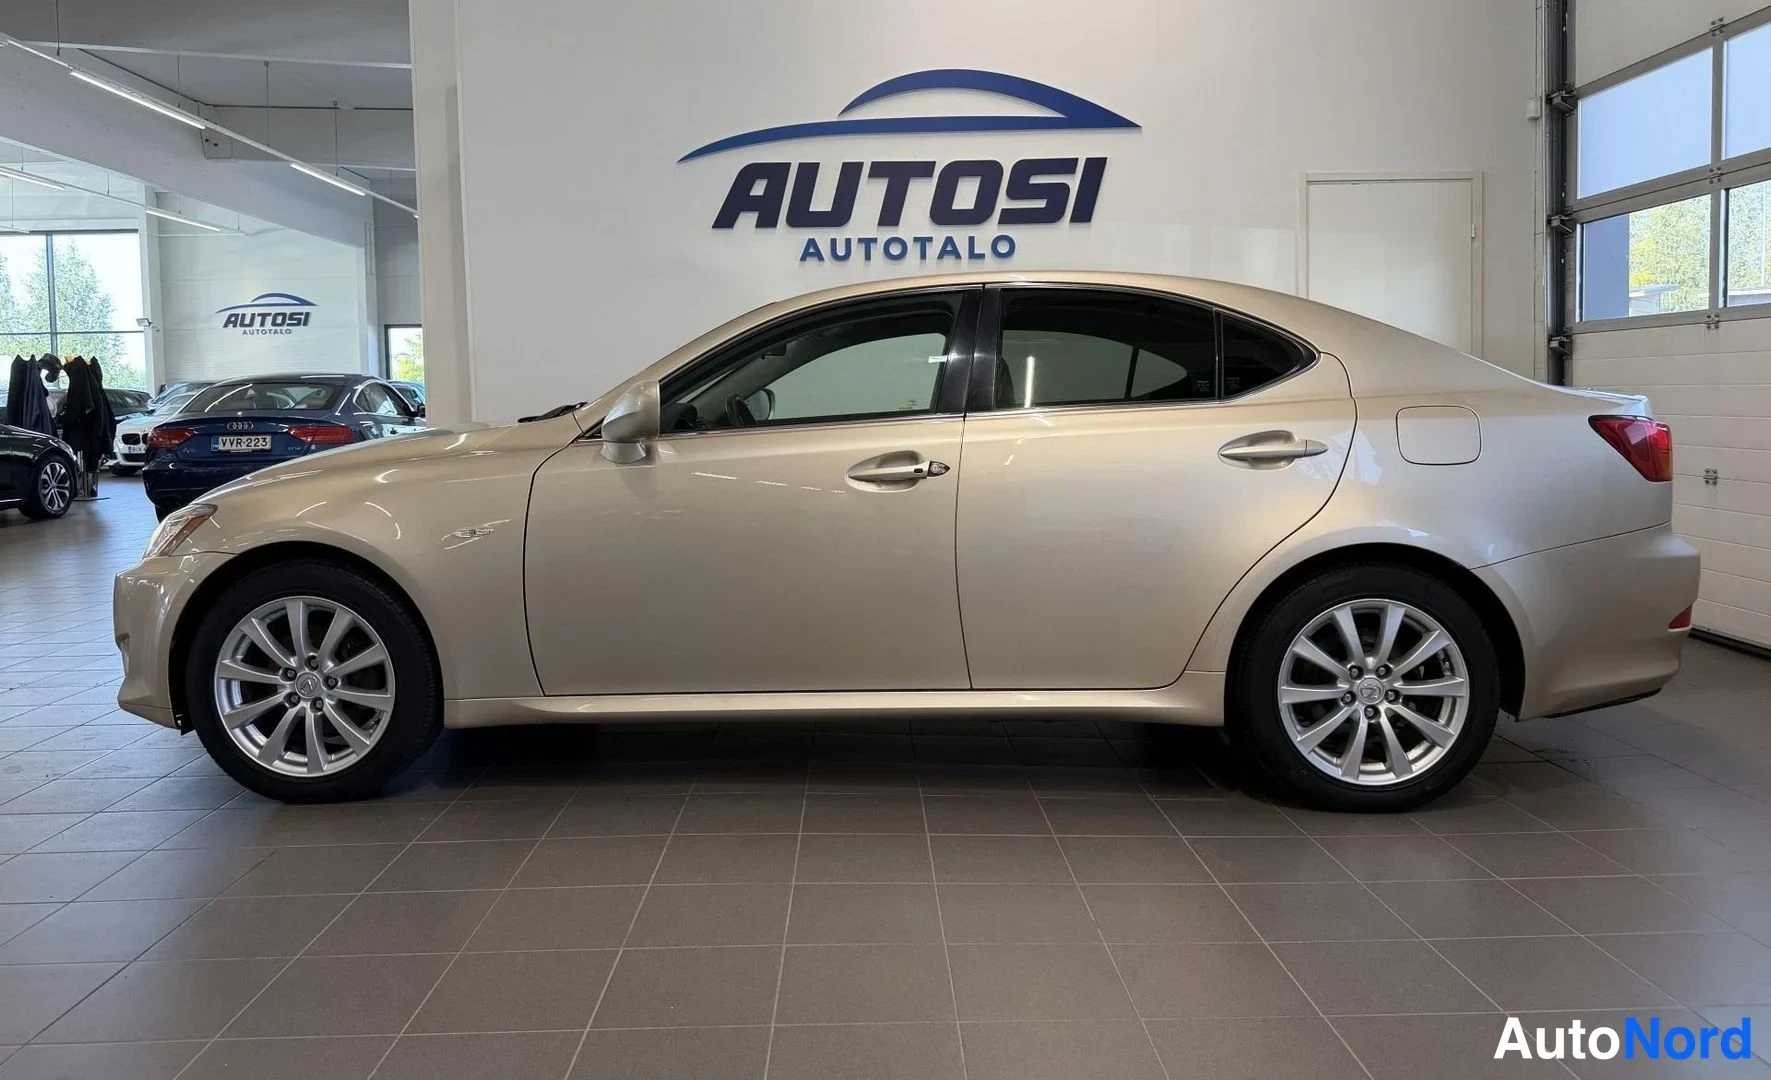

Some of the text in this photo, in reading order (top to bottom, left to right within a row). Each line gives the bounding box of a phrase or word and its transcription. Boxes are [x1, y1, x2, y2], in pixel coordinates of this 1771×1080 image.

[712, 156, 1108, 229] AUTOSI
[800, 234, 1016, 262] AUTOTALO
[222, 312, 311, 328] AUTOSI
[242, 328, 292, 336] AUTOTALO
[220, 437, 268, 448] VVR-223
